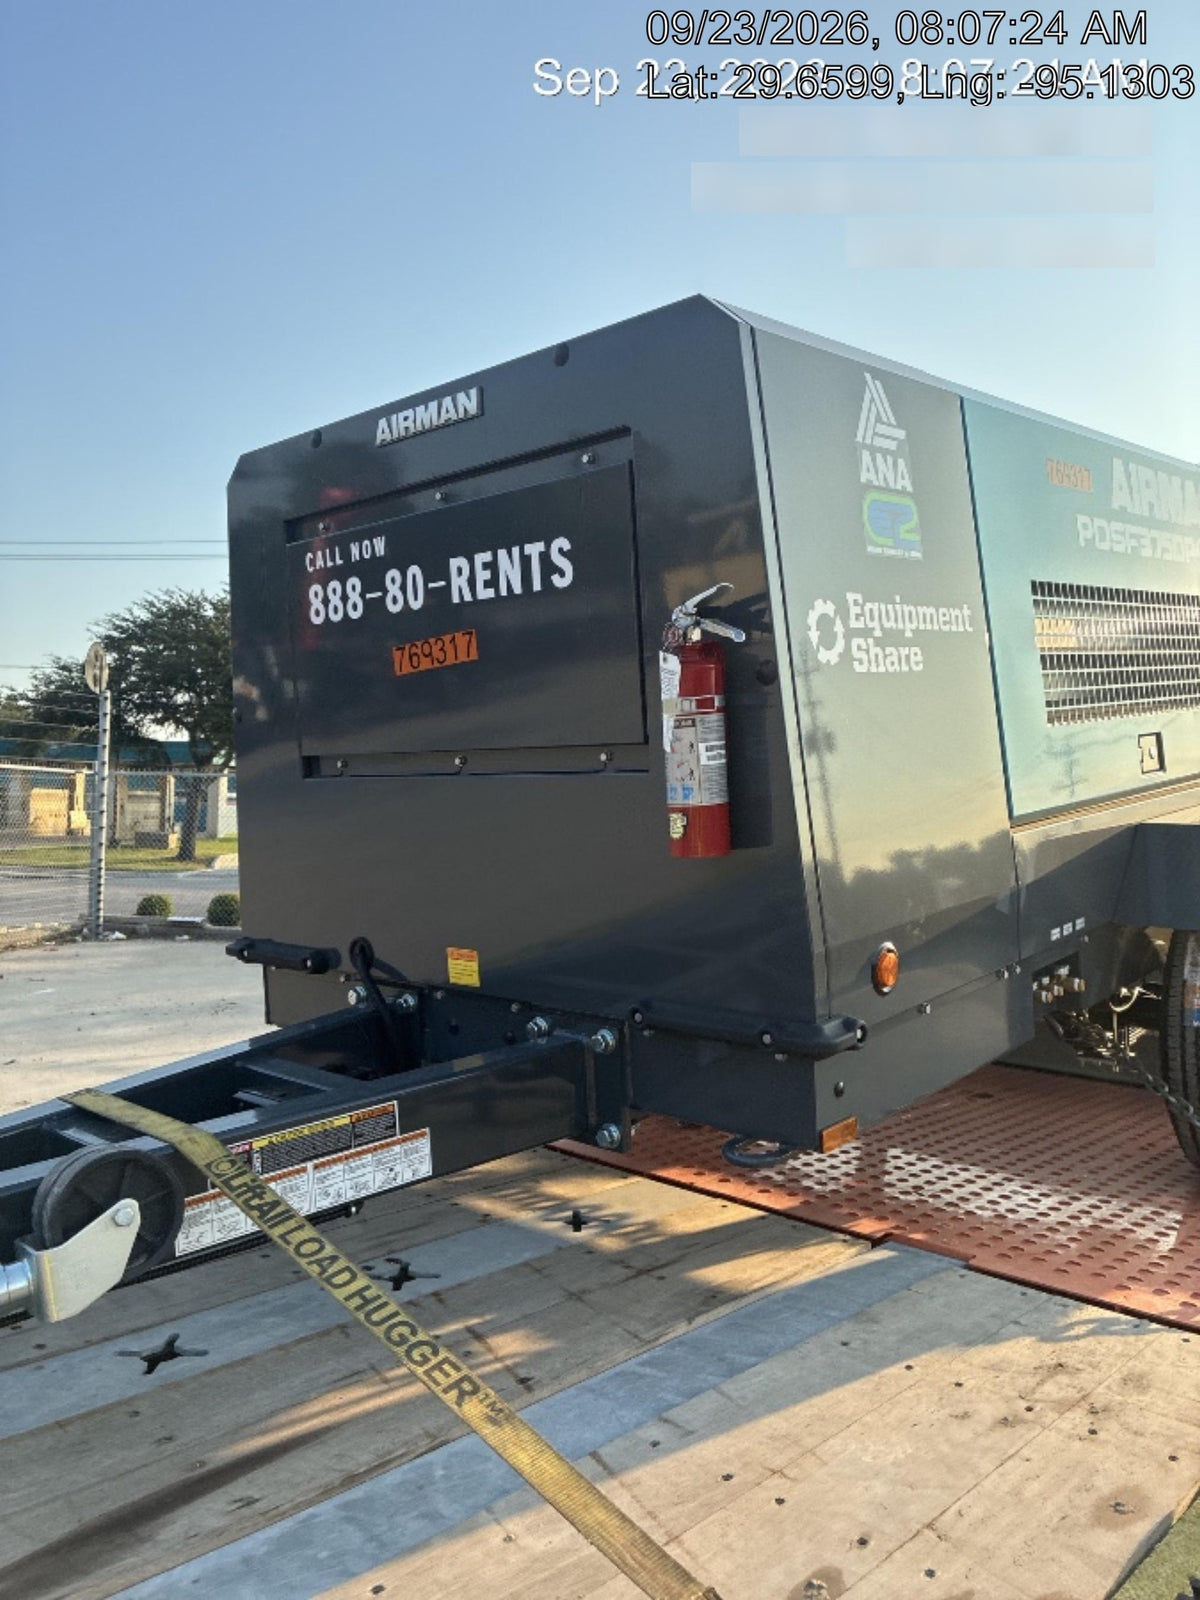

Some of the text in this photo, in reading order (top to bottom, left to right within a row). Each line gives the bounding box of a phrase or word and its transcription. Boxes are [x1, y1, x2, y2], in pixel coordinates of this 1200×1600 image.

[375, 386, 483, 447] AIRMAN
[860, 449, 913, 494] ANA
[305, 536, 386, 573] CALL NOW
[308, 536, 574, 625] 888-80-RENTS
[846, 592, 973, 637] Equipment
[394, 630, 475, 673] 769317
[852, 638, 924, 673] Share
[279, 1221, 358, 1290] LOAD
